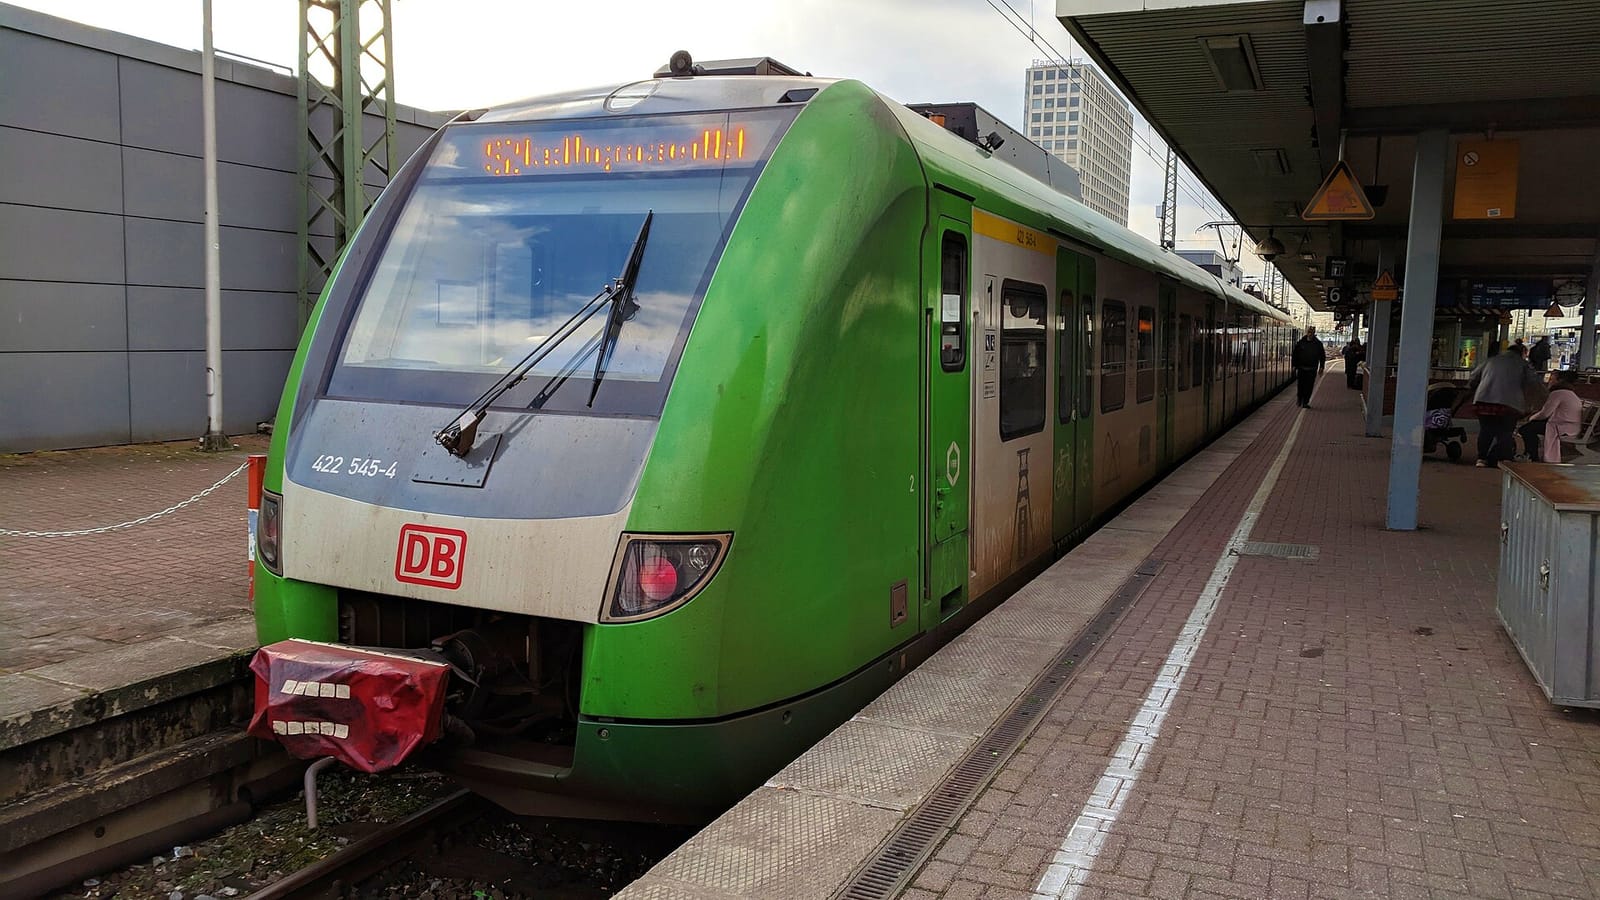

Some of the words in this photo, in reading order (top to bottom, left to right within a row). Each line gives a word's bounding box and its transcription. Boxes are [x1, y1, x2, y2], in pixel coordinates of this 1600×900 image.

[1330, 288, 1340, 302] 6
[311, 455, 343, 474] 422
[348, 458, 398, 479] 545-4
[910, 474, 915, 493] 2
[404, 533, 456, 578] DB
